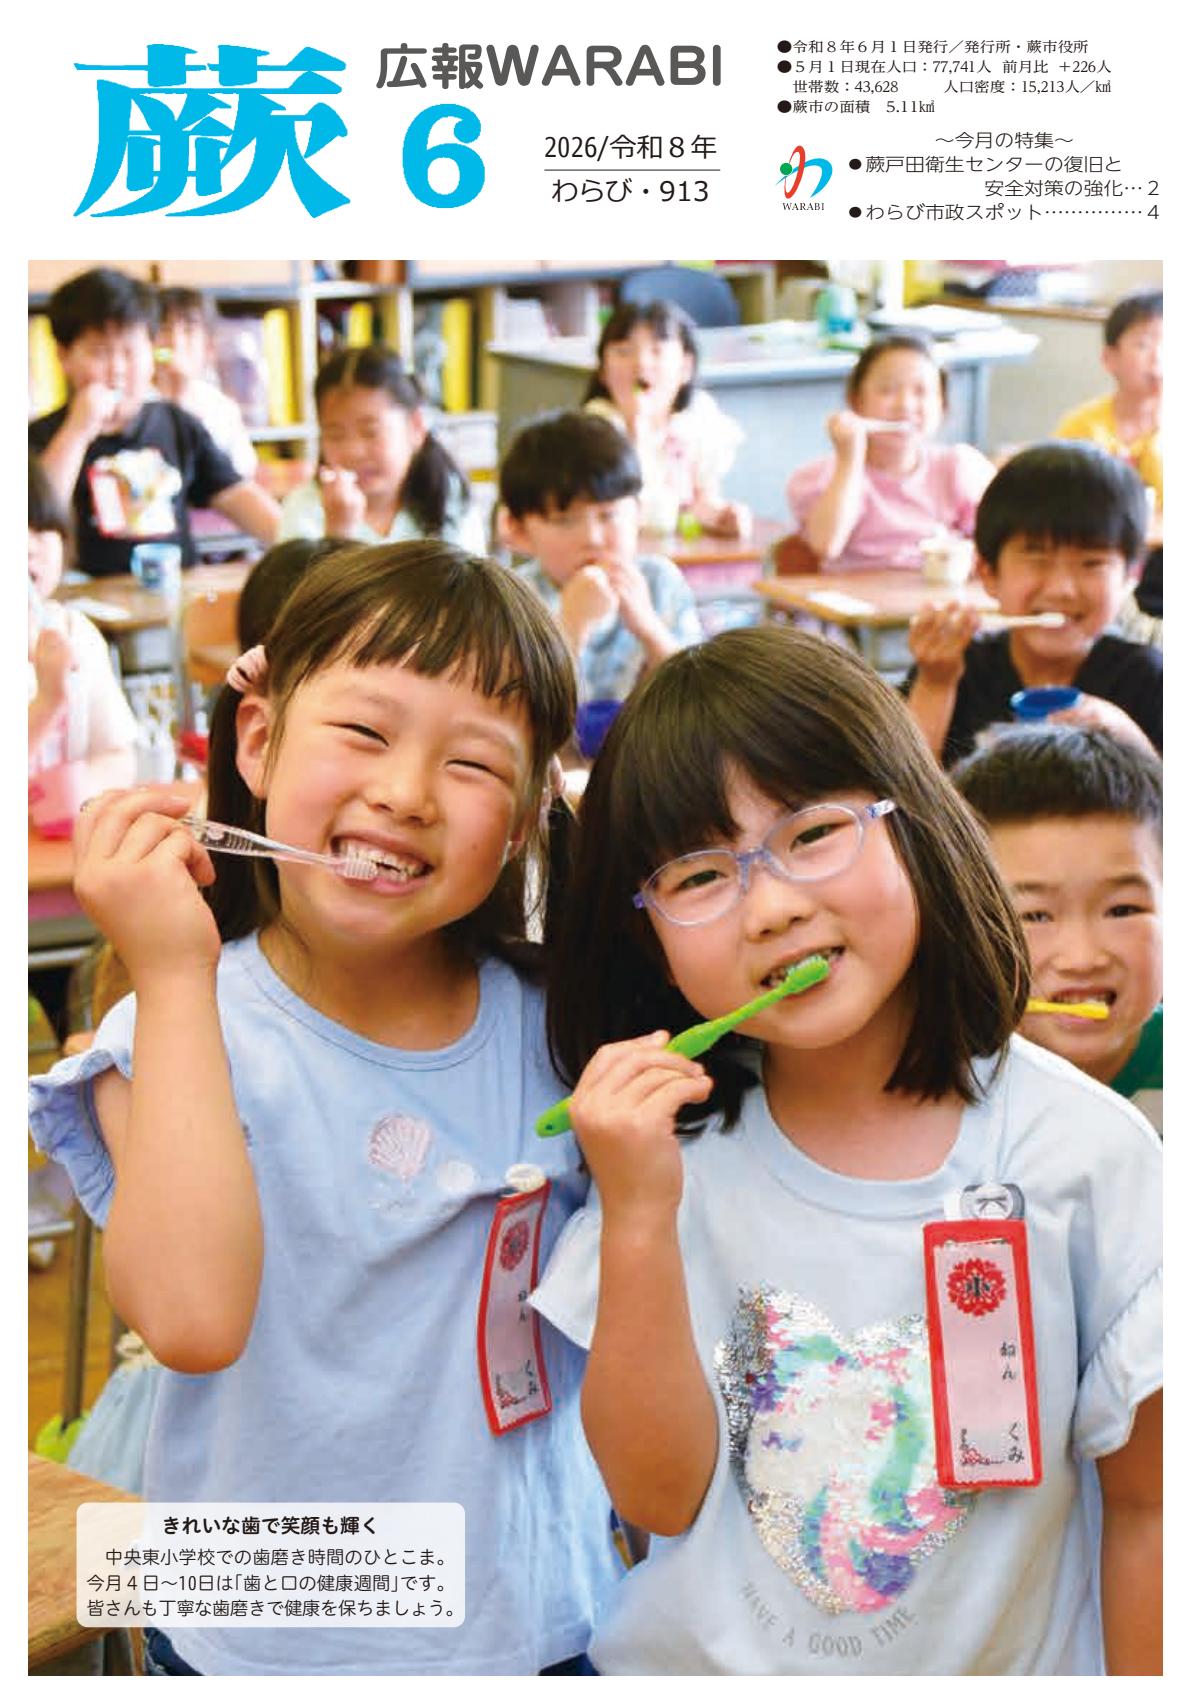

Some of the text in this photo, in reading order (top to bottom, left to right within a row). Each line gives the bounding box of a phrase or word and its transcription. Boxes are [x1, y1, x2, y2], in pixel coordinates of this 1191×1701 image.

[376, 43, 721, 89] 広報WARABI
[1003, 60, 1049, 74] 前月比
[793, 80, 899, 94] 世帯数：43,628
[793, 100, 871, 114] 蕨市の面積
[73, 44, 350, 218] 蕨
[402, 104, 485, 208] 6
[545, 135, 717, 162] 2026/令和8年
[865, 156, 1121, 174] 蕨戸田衛生センターの復旧と
[551, 178, 709, 203] わらび・913
[1147, 181, 1160, 196] 2
[782, 203, 825, 211] WARABI
[1147, 205, 1160, 220] 4
[807, 1630, 863, 1658] GOOD
[869, 1605, 917, 1648] TIME
